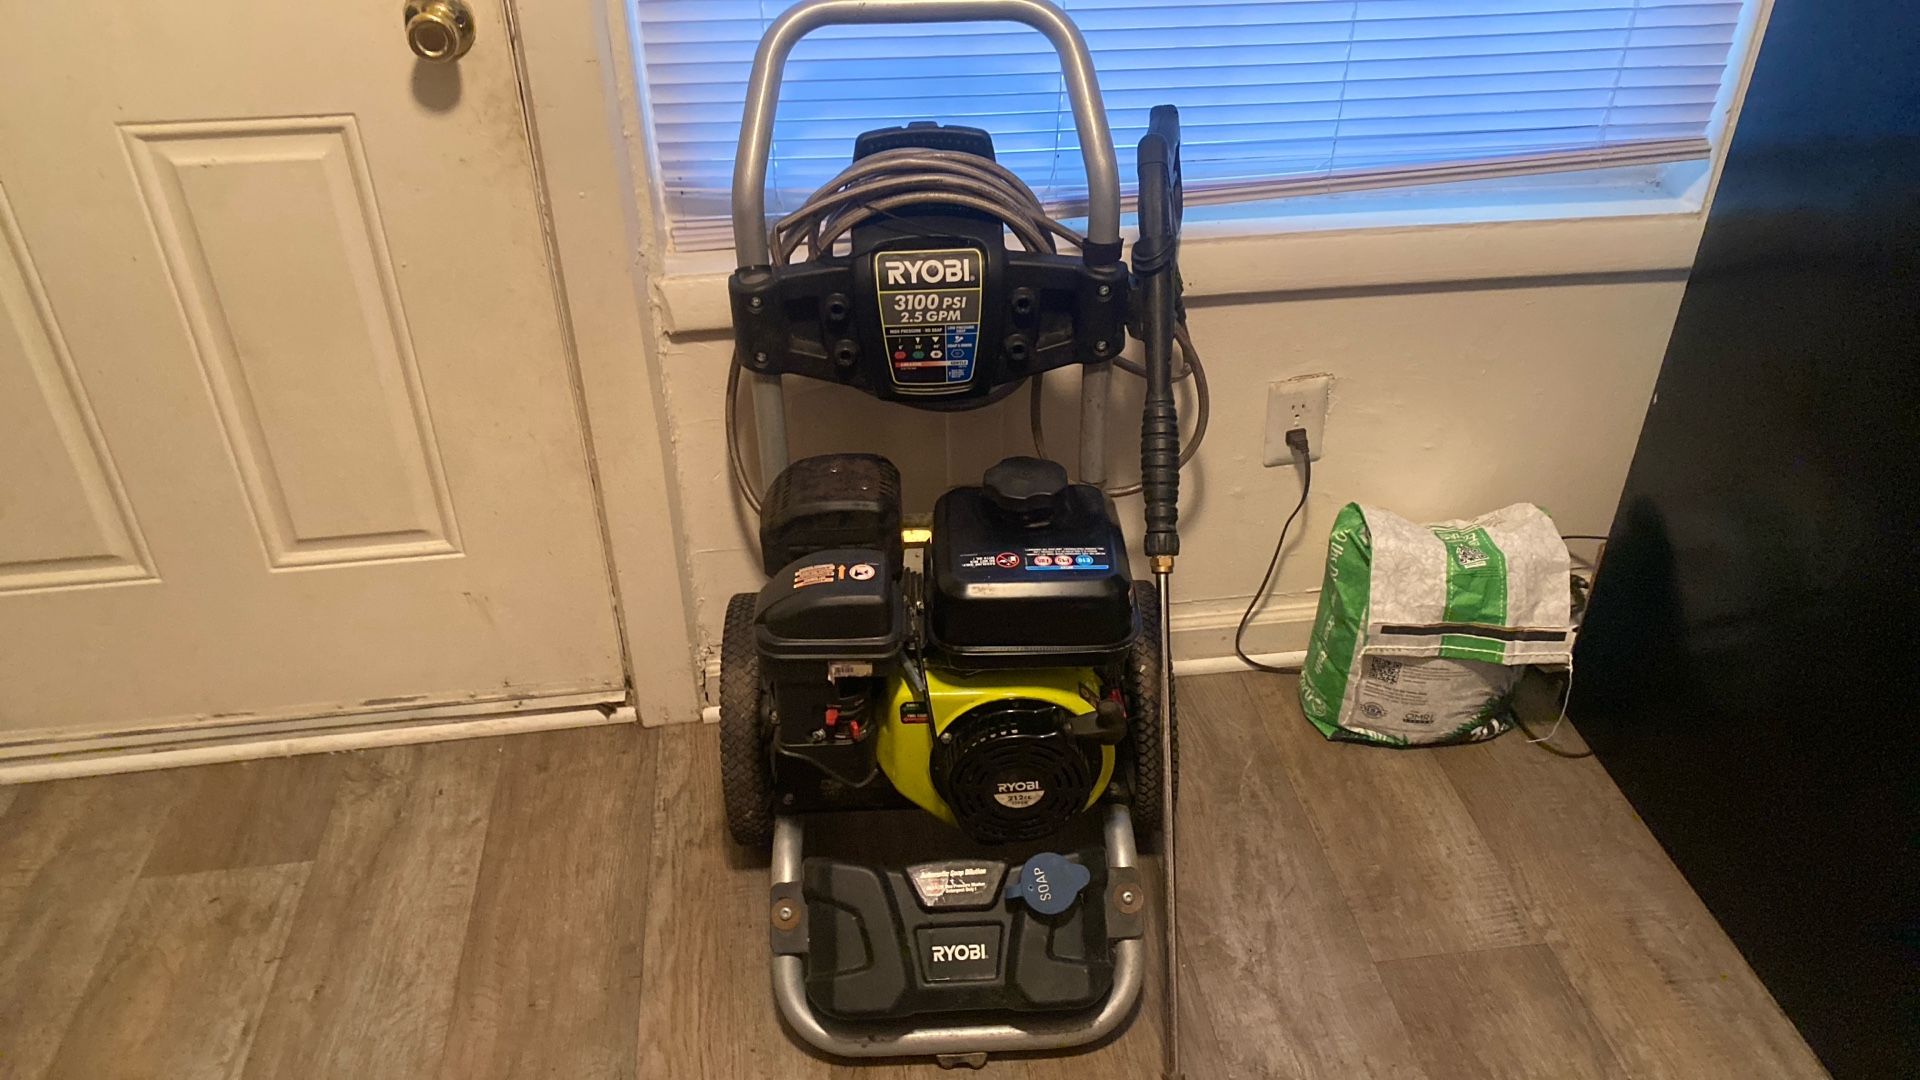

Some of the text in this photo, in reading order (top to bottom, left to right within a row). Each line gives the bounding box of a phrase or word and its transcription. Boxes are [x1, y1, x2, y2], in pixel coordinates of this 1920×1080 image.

[885, 258, 971, 285] RYOBI
[894, 294, 967, 311] 3100 PSI
[900, 310, 961, 323] 2.5 GPM
[997, 781, 1039, 792] RYOBI
[1034, 867, 1051, 901] SOAP
[932, 944, 987, 962] RYOBI
